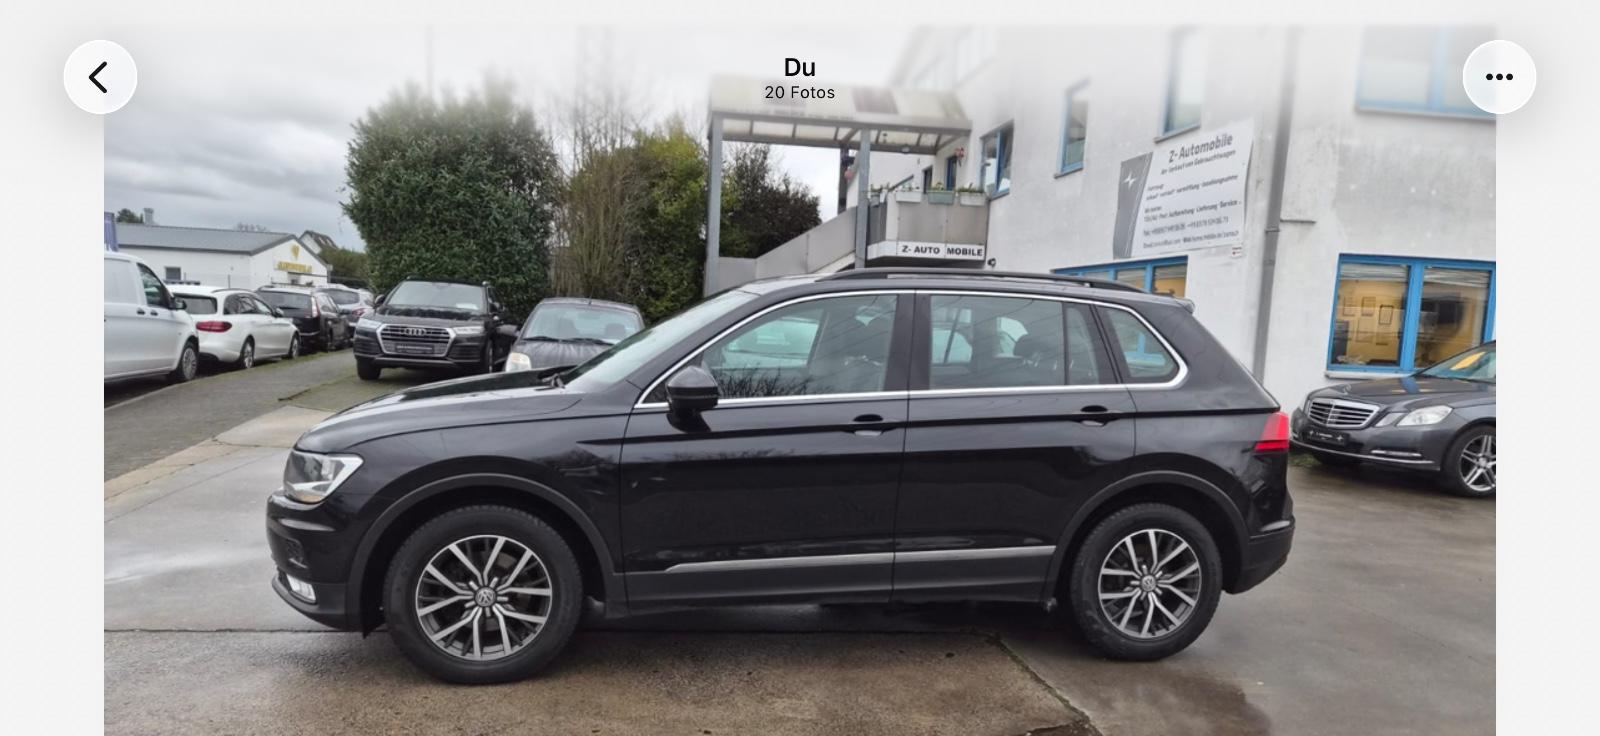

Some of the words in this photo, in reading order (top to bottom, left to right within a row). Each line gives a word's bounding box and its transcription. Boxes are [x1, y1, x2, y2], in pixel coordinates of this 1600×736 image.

[1179, 134, 1234, 159] Automobile
[902, 245, 911, 253] Z-
[914, 246, 940, 254] AUTO
[946, 247, 983, 256] MOBILE
